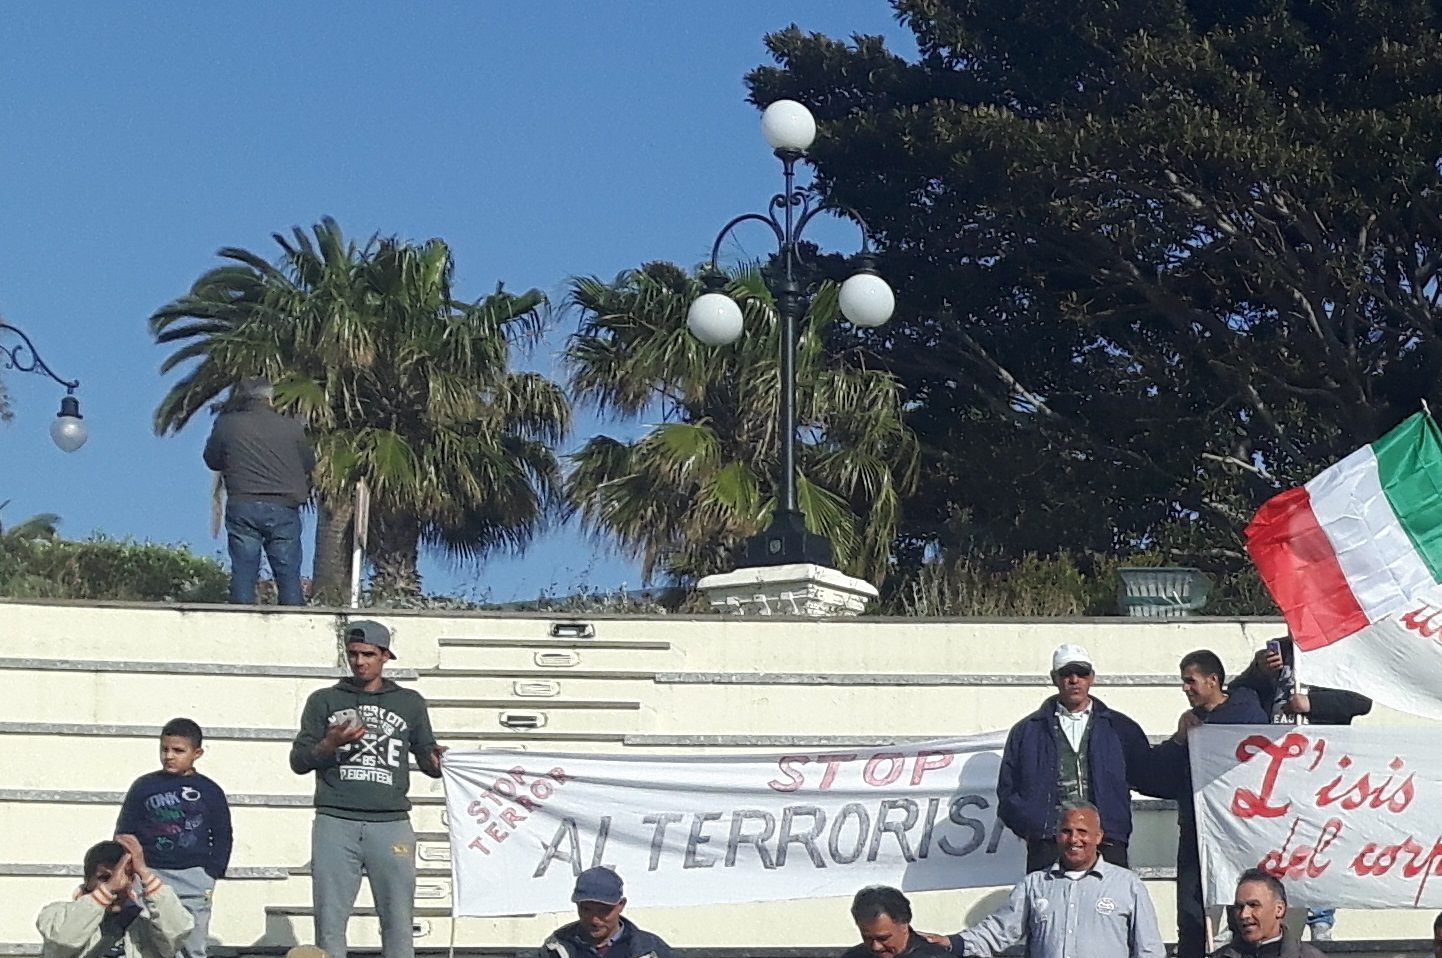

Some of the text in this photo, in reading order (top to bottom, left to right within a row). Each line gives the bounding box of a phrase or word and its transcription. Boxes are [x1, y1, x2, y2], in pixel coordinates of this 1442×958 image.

[467, 765, 526, 825] STOP
[767, 749, 955, 793] STOP
[1230, 732, 1417, 818] L'isis
[467, 766, 568, 856] TERROR
[642, 794, 1006, 872] TERRORIS
[1257, 816, 1344, 879] del
